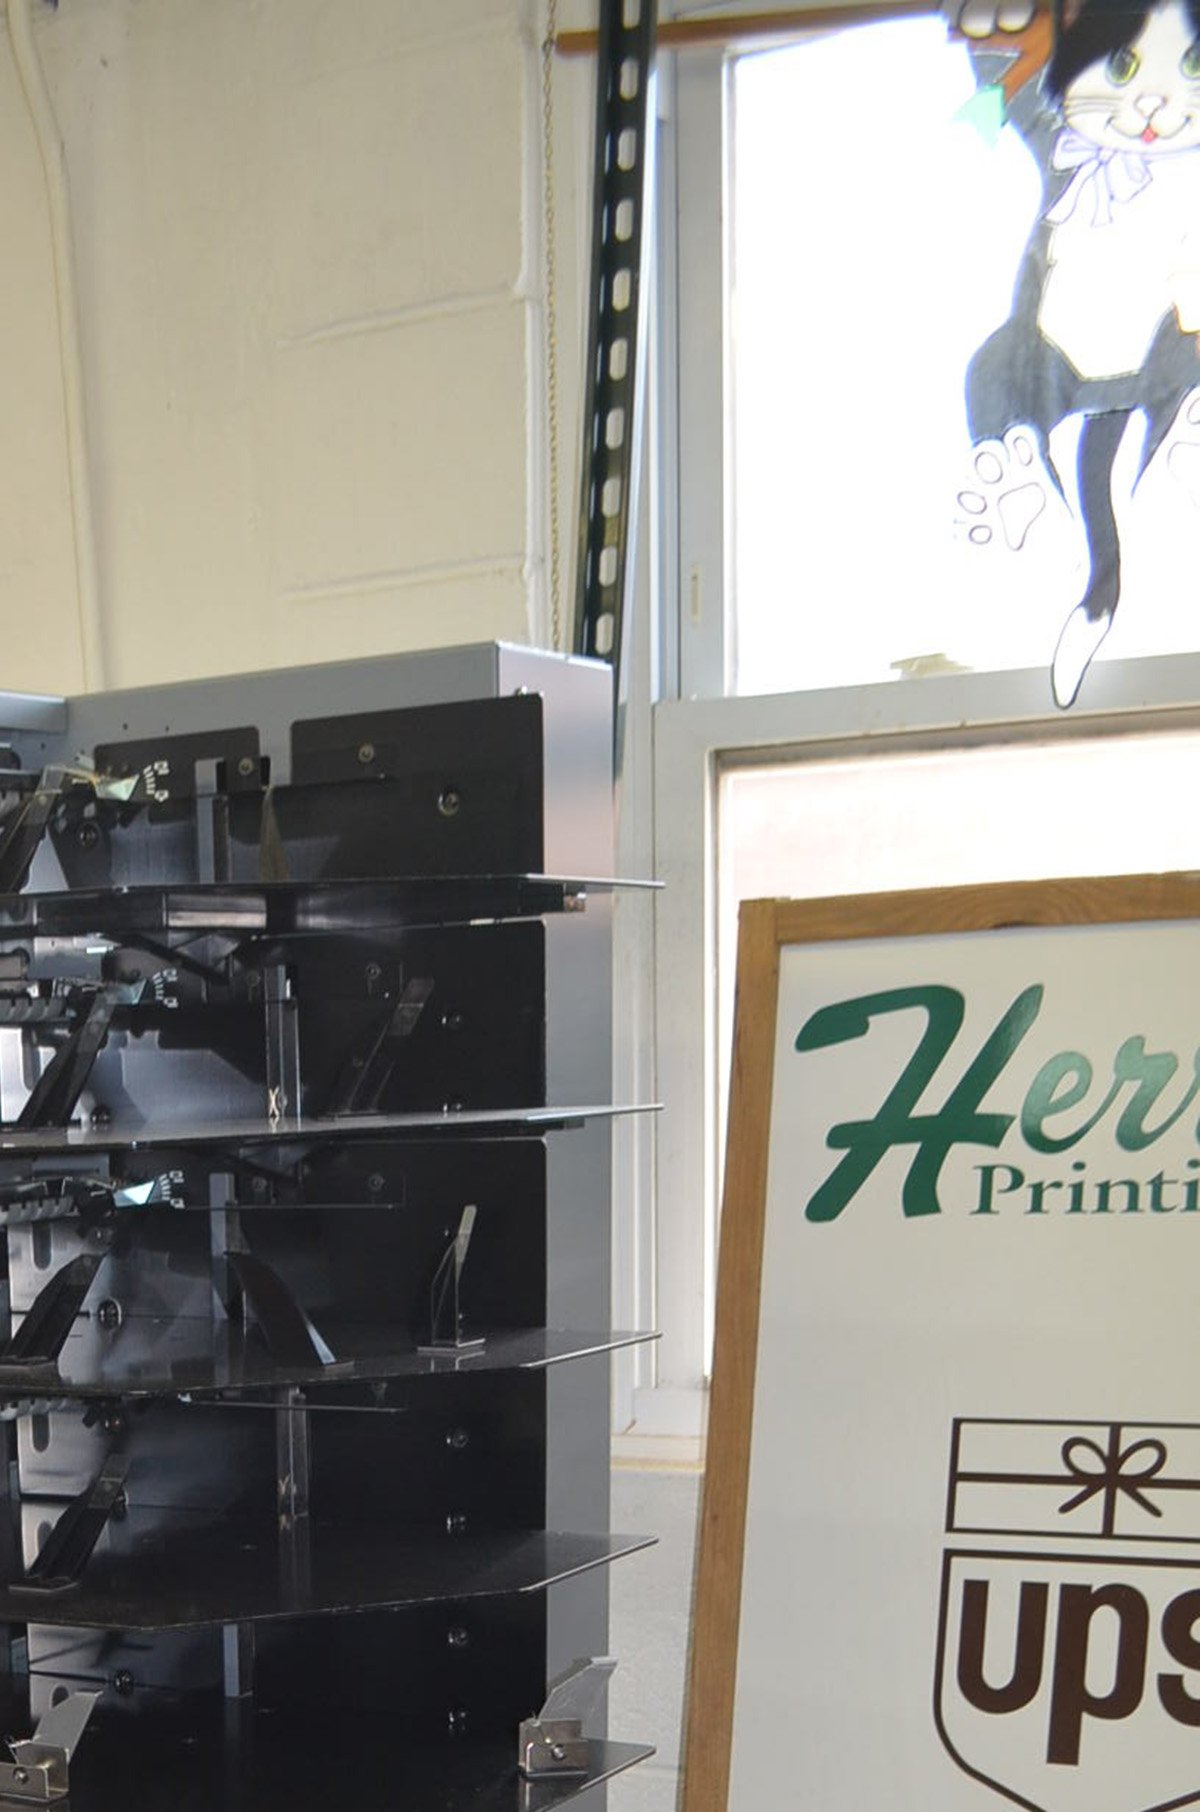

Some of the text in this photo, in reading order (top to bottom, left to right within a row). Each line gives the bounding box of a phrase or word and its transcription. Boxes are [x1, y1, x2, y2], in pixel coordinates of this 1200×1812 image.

[795, 983, 1200, 1223] Her
[969, 1161, 1200, 1216] Printi
[956, 1578, 1200, 1766] ups
